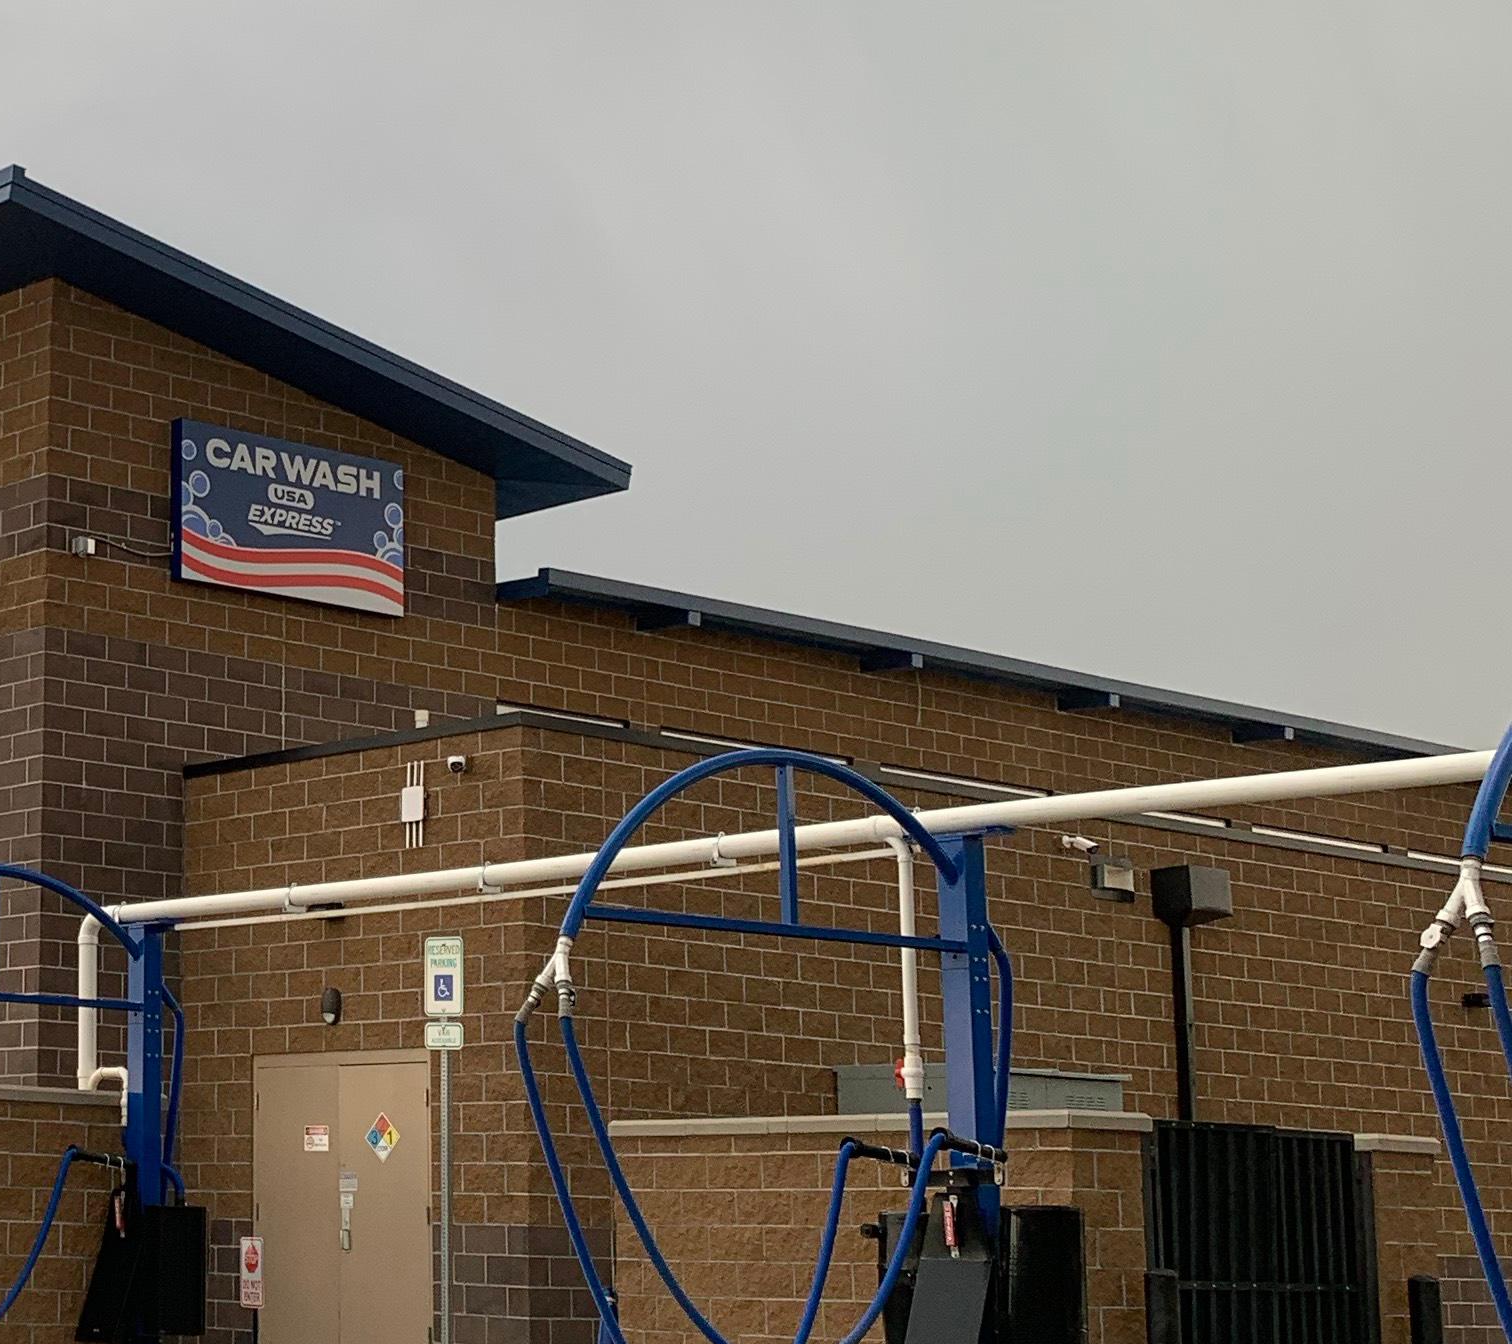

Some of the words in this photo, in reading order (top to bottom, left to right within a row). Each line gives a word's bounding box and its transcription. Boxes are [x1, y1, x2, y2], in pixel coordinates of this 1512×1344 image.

[205, 437, 277, 479] CAR
[280, 451, 381, 499] WASH
[273, 487, 308, 506] USA
[248, 503, 334, 535] EXPRESS
[370, 1129, 378, 1145] 3
[386, 1130, 393, 1146] 1
